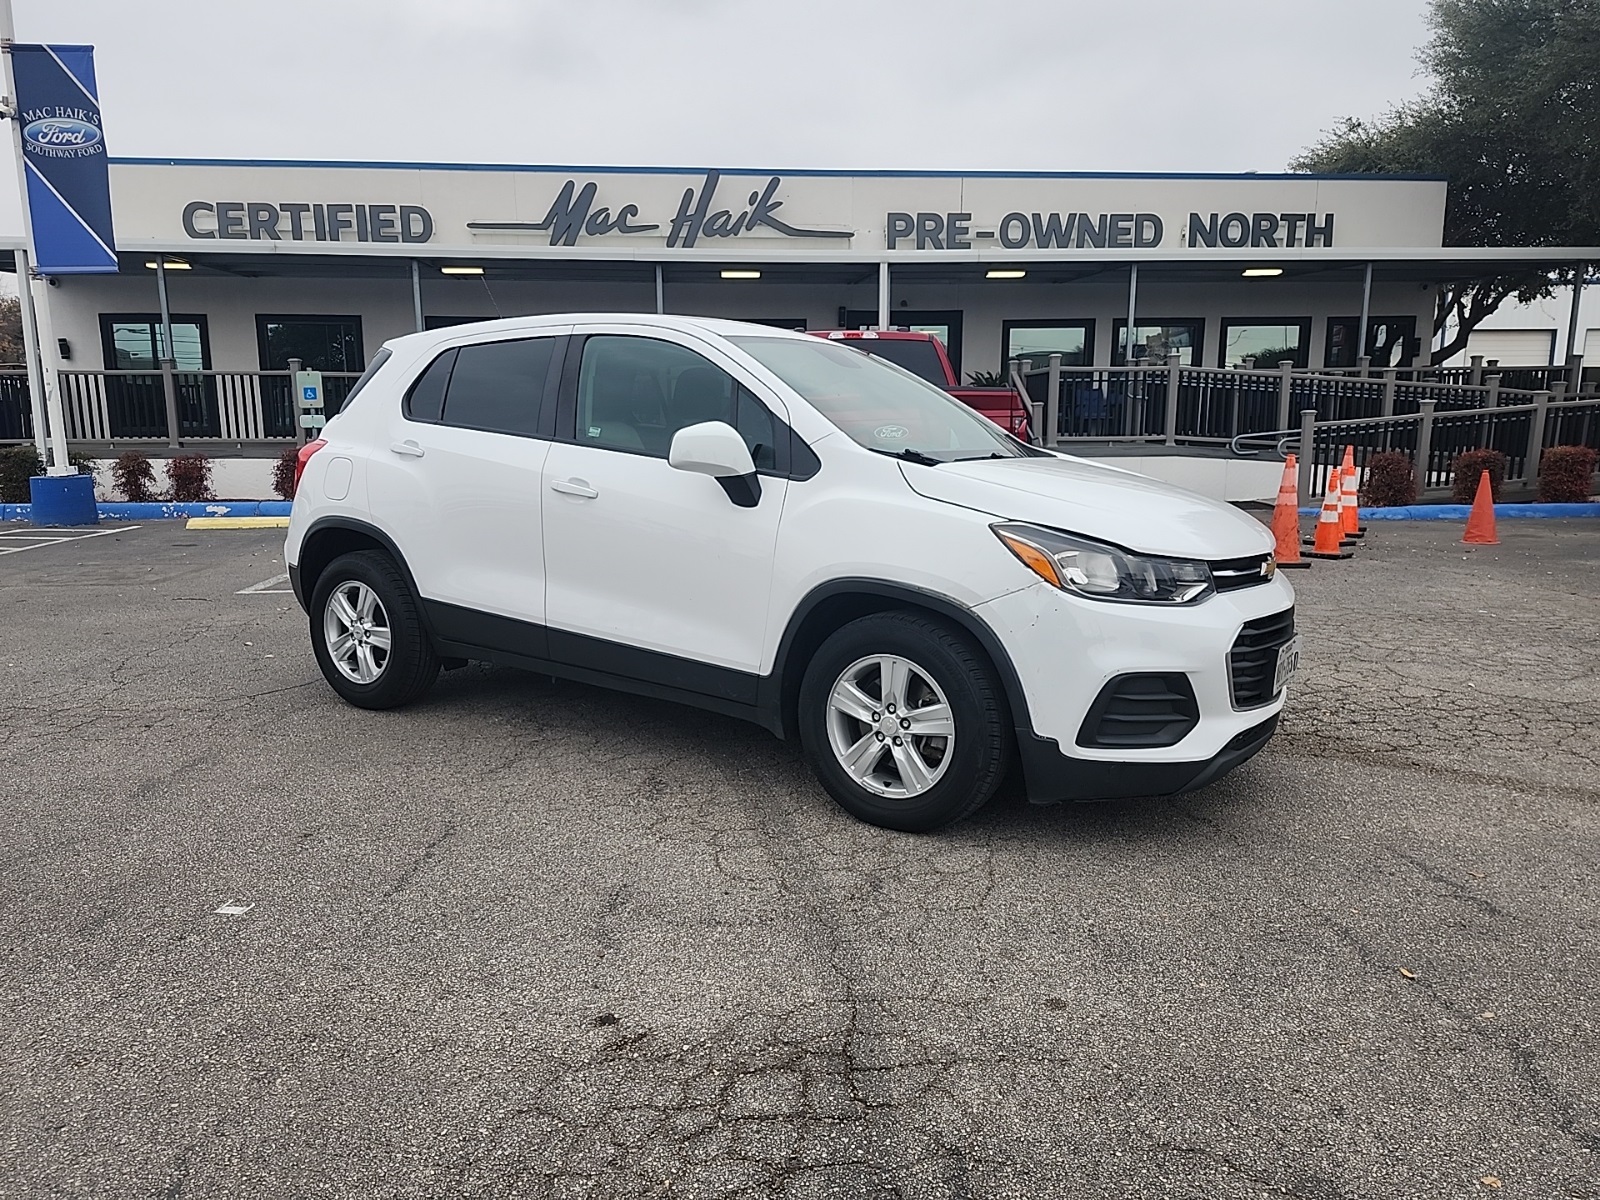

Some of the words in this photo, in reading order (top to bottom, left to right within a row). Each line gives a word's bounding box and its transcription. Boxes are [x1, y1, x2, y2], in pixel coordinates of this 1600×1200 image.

[23, 107, 52, 123] MAC
[55, 106, 99, 125] HAIK'S
[38, 123, 85, 143] Ford
[26, 142, 76, 158] SOUTHWAY
[77, 144, 102, 157] FORD
[467, 180, 660, 247] Mac
[666, 169, 855, 248] Haik
[182, 200, 434, 243] CERTIFIED
[886, 212, 1164, 250] PRE-OWNED
[1188, 212, 1335, 248] NORTH
[880, 427, 903, 438] Ford
